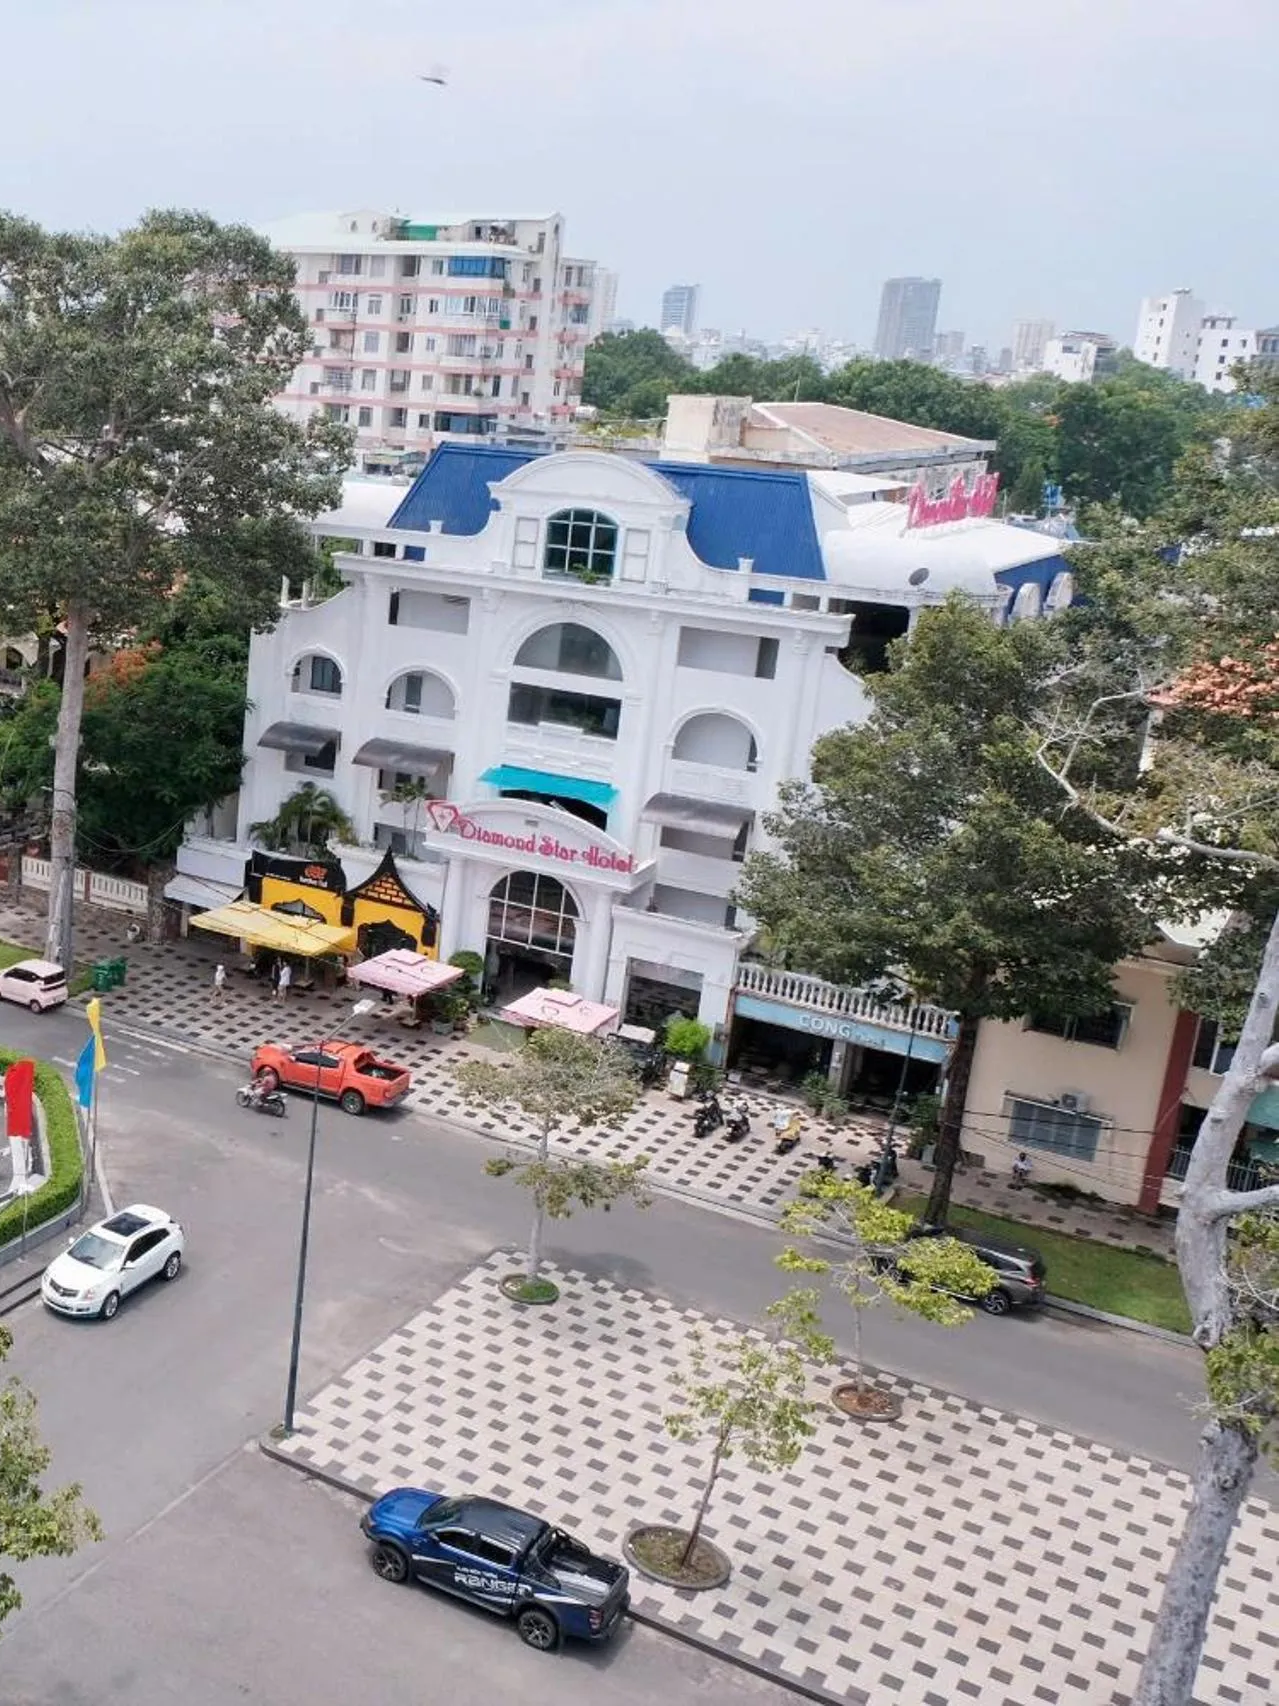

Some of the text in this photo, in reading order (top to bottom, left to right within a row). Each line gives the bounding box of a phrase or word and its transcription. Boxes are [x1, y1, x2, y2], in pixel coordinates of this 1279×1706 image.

[459, 819, 634, 874] Diamond Star Hotel
